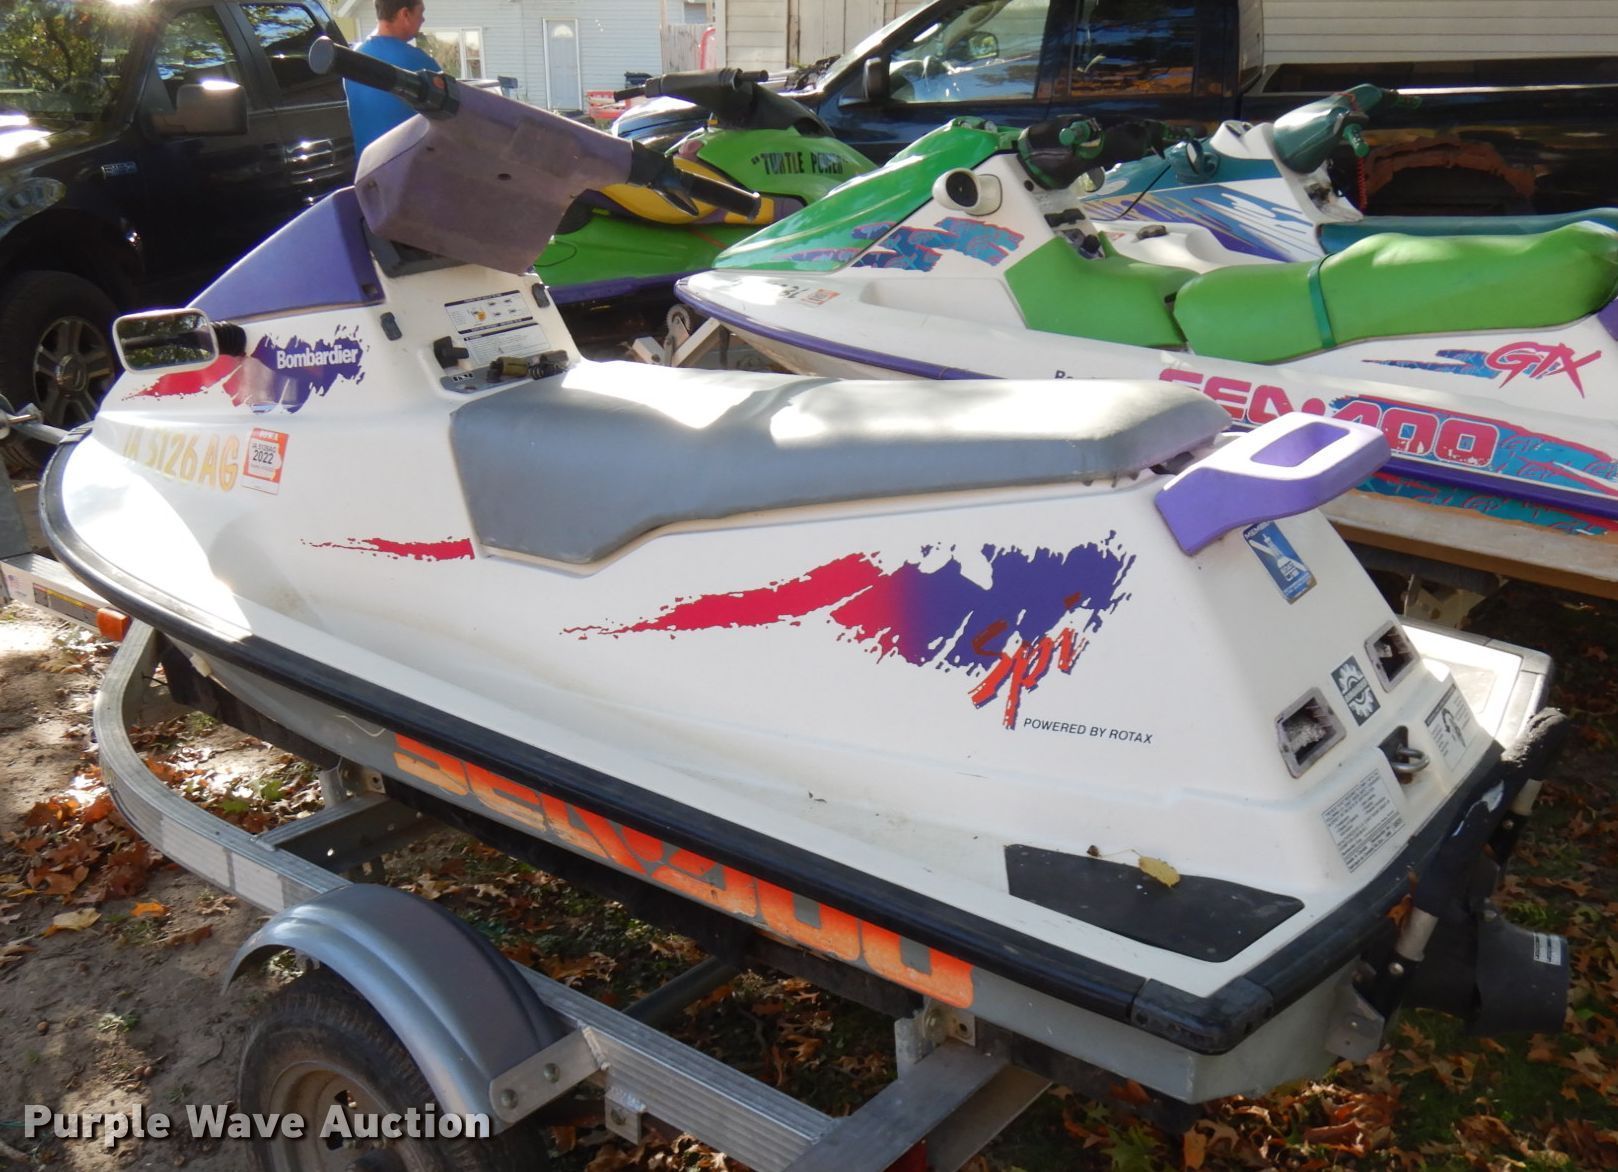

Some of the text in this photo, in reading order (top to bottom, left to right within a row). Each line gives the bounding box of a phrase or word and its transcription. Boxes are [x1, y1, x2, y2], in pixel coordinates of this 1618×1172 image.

[276, 344, 359, 369] Bombardier
[1486, 341, 1602, 399] GTX
[253, 449, 274, 465] 2022
[1023, 718, 1153, 744] POWERED BY ROTAX
